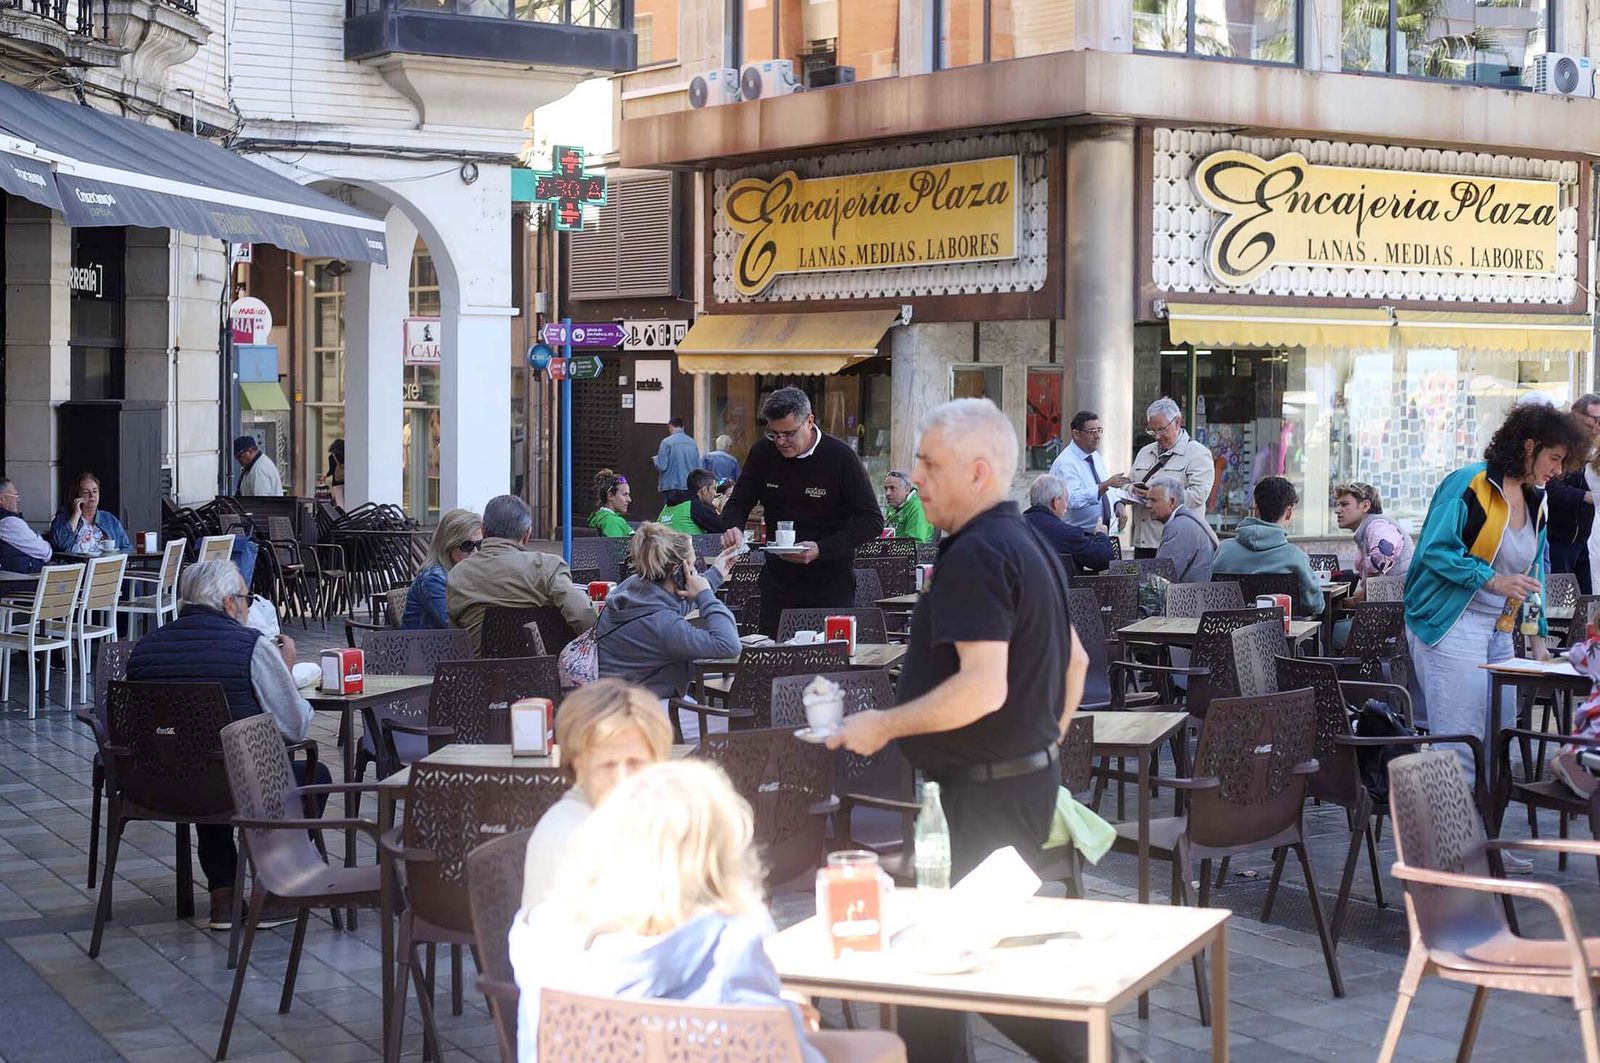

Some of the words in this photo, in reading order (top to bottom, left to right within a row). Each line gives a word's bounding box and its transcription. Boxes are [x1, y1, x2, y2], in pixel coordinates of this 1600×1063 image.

[726, 176, 900, 288] Encajeria
[904, 170, 1010, 214] Plaza
[799, 245, 847, 268] LANAS
[855, 240, 916, 264] MEDIAS
[927, 233, 1000, 260] LABORES
[1203, 160, 1440, 276] Encajeria
[1444, 180, 1557, 228] Plaza
[1307, 238, 1367, 261] LANAS
[1384, 242, 1454, 266] MEDIAS
[1470, 246, 1544, 270] LABORES
